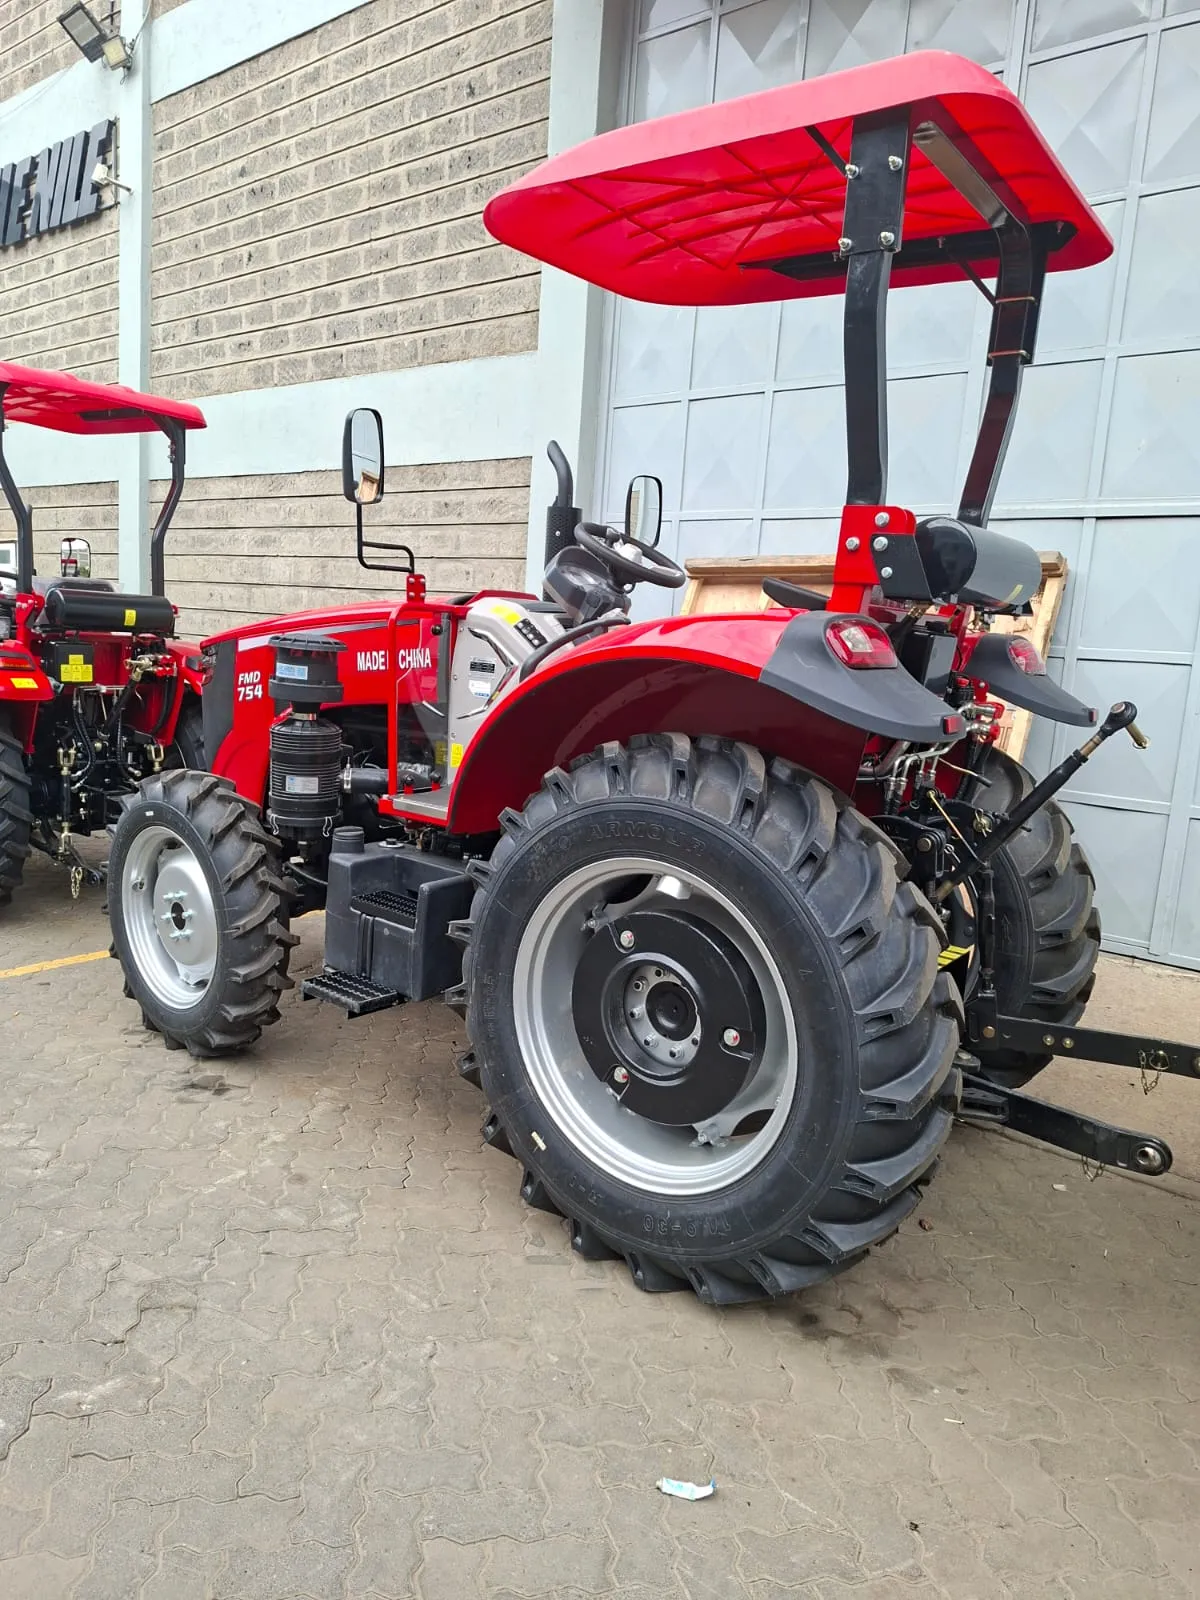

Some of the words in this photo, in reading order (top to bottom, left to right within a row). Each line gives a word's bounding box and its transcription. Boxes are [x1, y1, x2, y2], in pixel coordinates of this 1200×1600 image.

[29, 119, 115, 236] NILE
[357, 650, 386, 672] MADE
[398, 647, 432, 669] CHINA
[238, 670, 261, 686] FMD
[237, 684, 262, 702] 754
